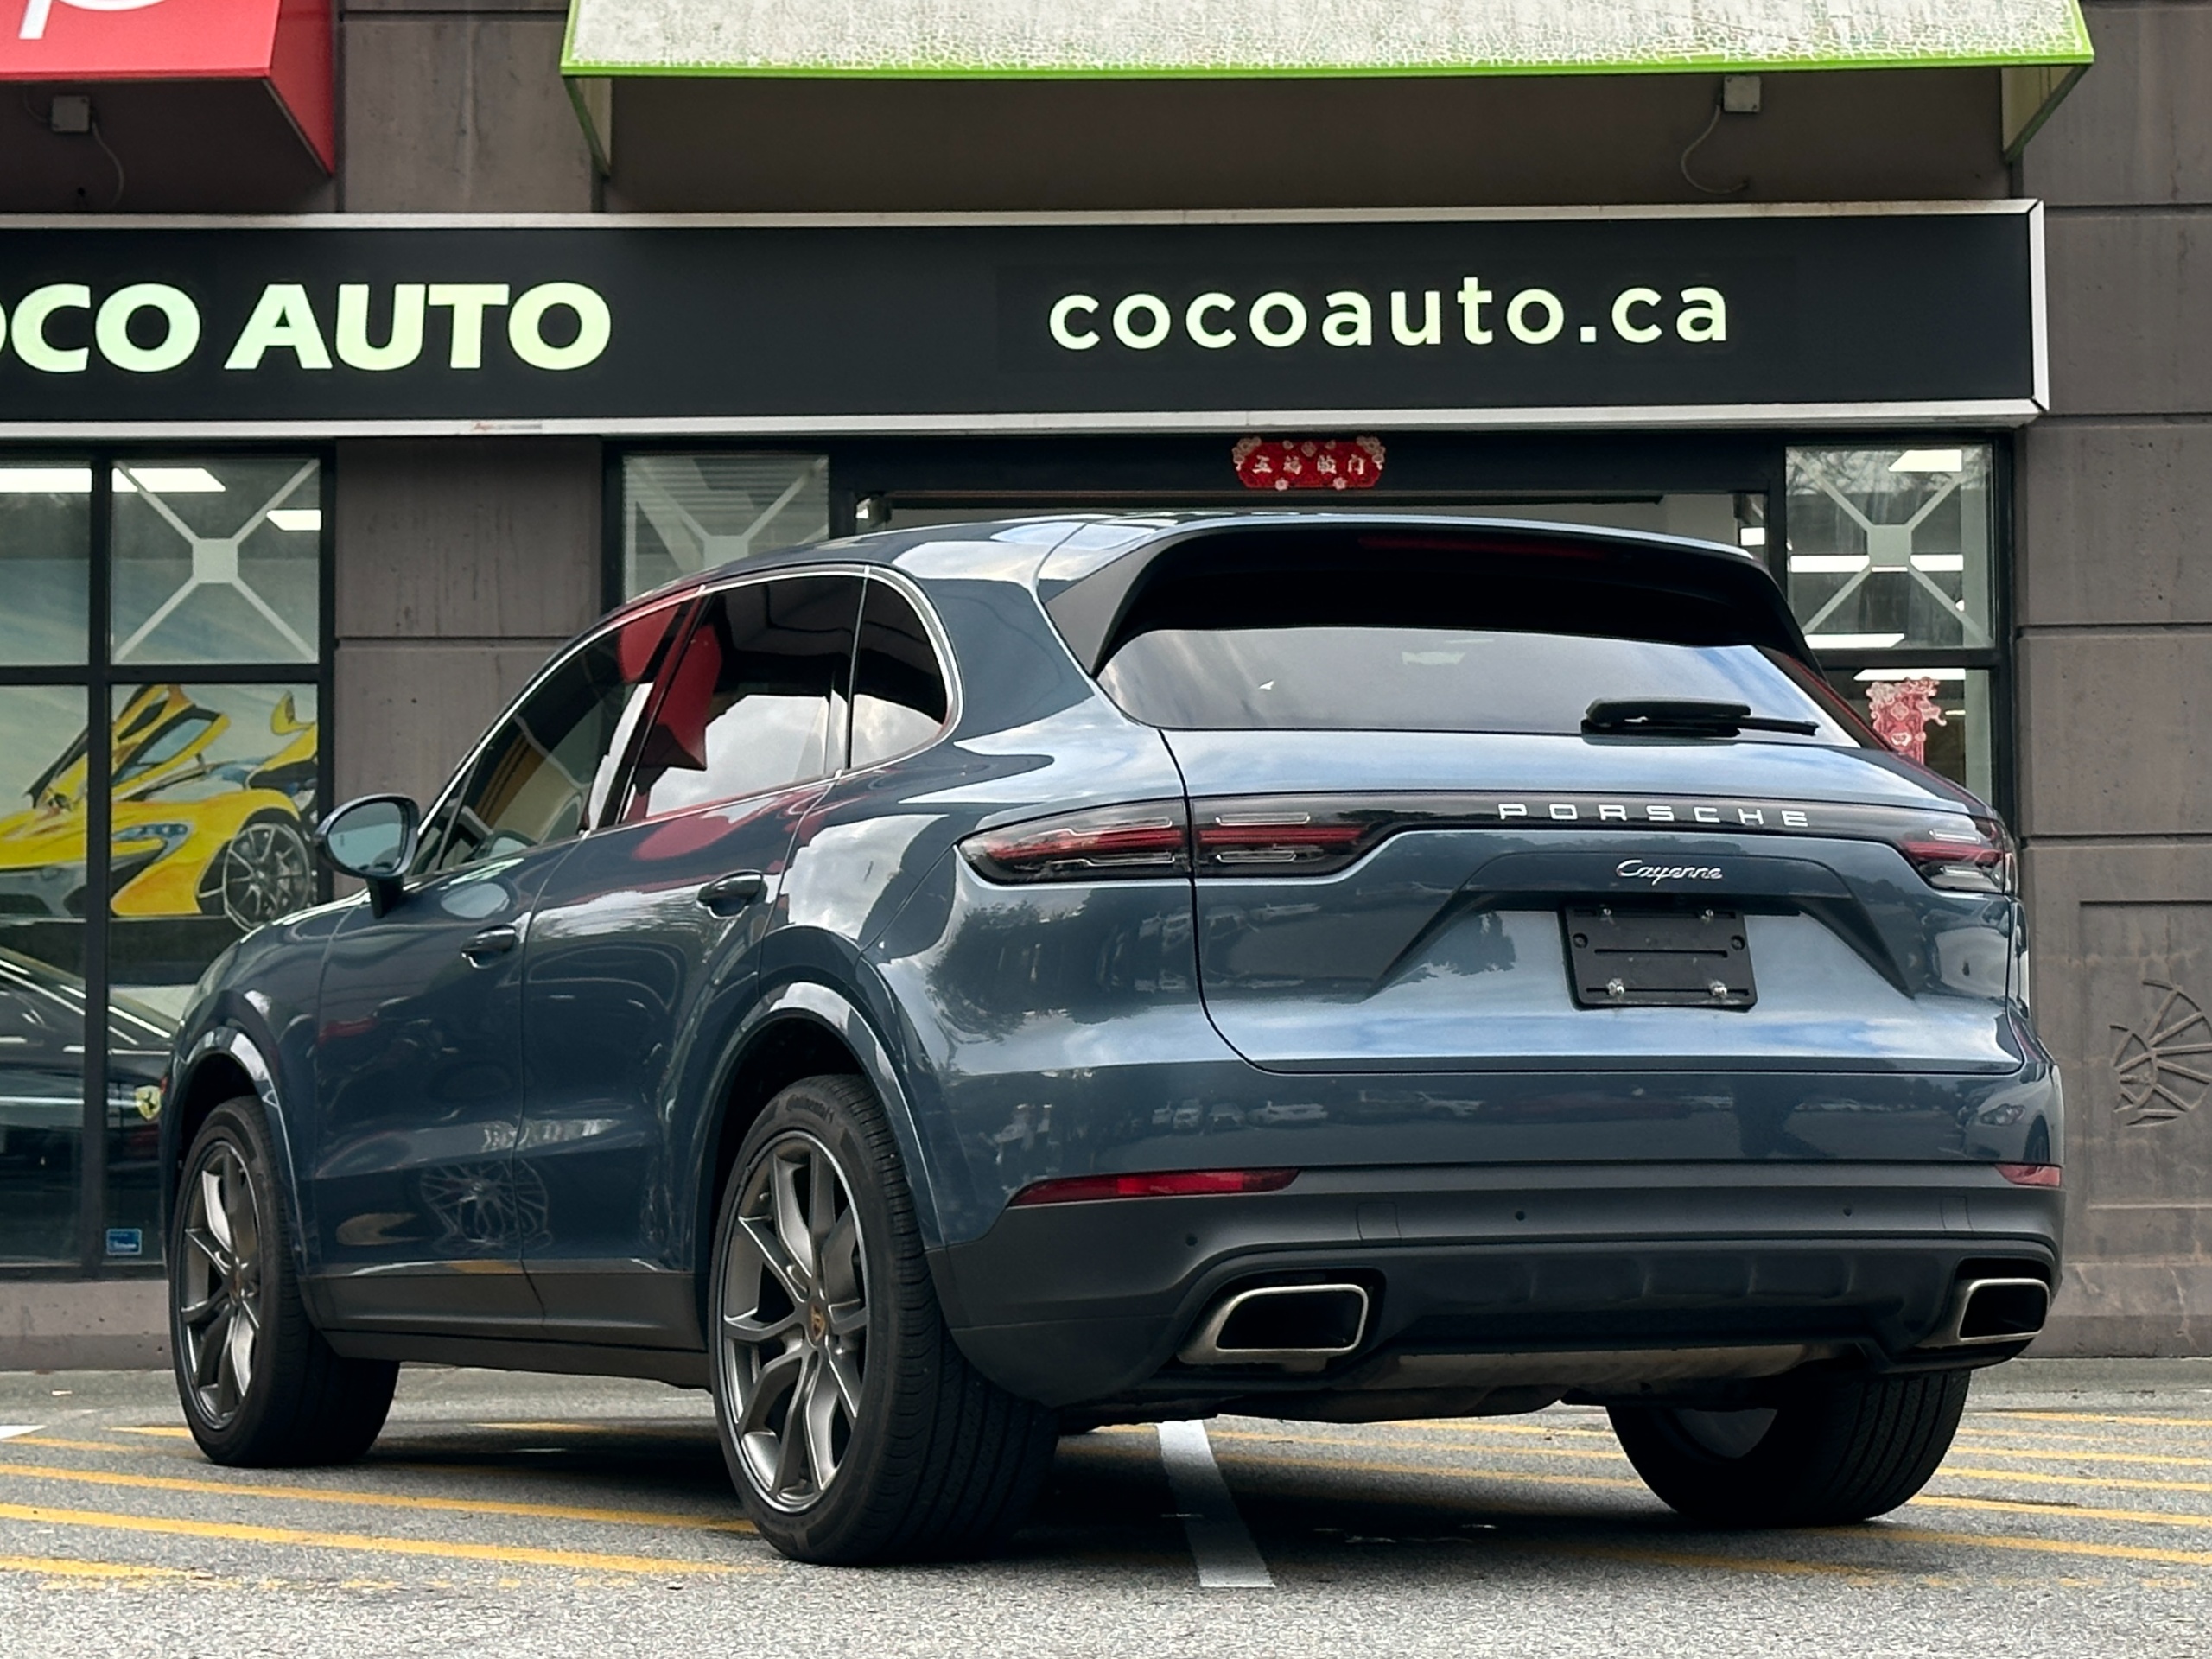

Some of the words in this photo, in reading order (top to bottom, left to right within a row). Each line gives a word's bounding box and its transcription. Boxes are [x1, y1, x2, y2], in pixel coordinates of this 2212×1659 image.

[0, 283, 200, 372] CO
[224, 282, 611, 371] AUTO
[1049, 276, 1726, 350] cocoauto.ca
[1498, 804, 1808, 827] PORSCHE
[1617, 859, 1723, 886] Cayenne
